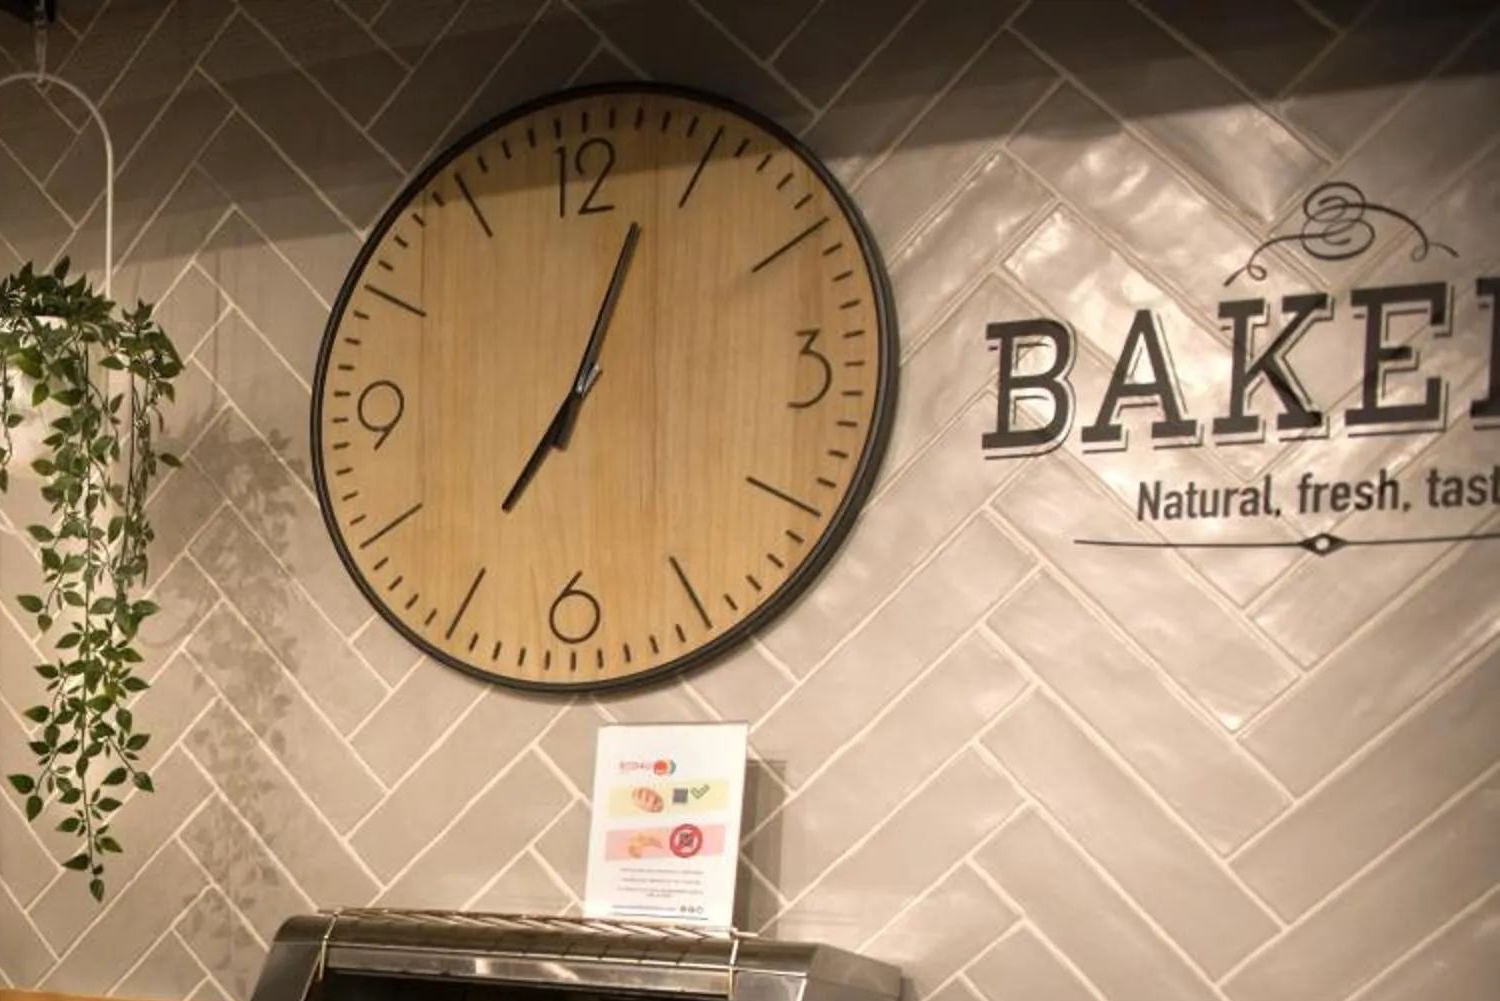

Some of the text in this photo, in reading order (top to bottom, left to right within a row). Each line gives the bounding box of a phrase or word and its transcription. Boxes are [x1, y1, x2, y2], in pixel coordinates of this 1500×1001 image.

[553, 137, 616, 218] 12
[788, 328, 833, 409] 3
[357, 380, 406, 450] 9
[549, 570, 601, 645] 6
